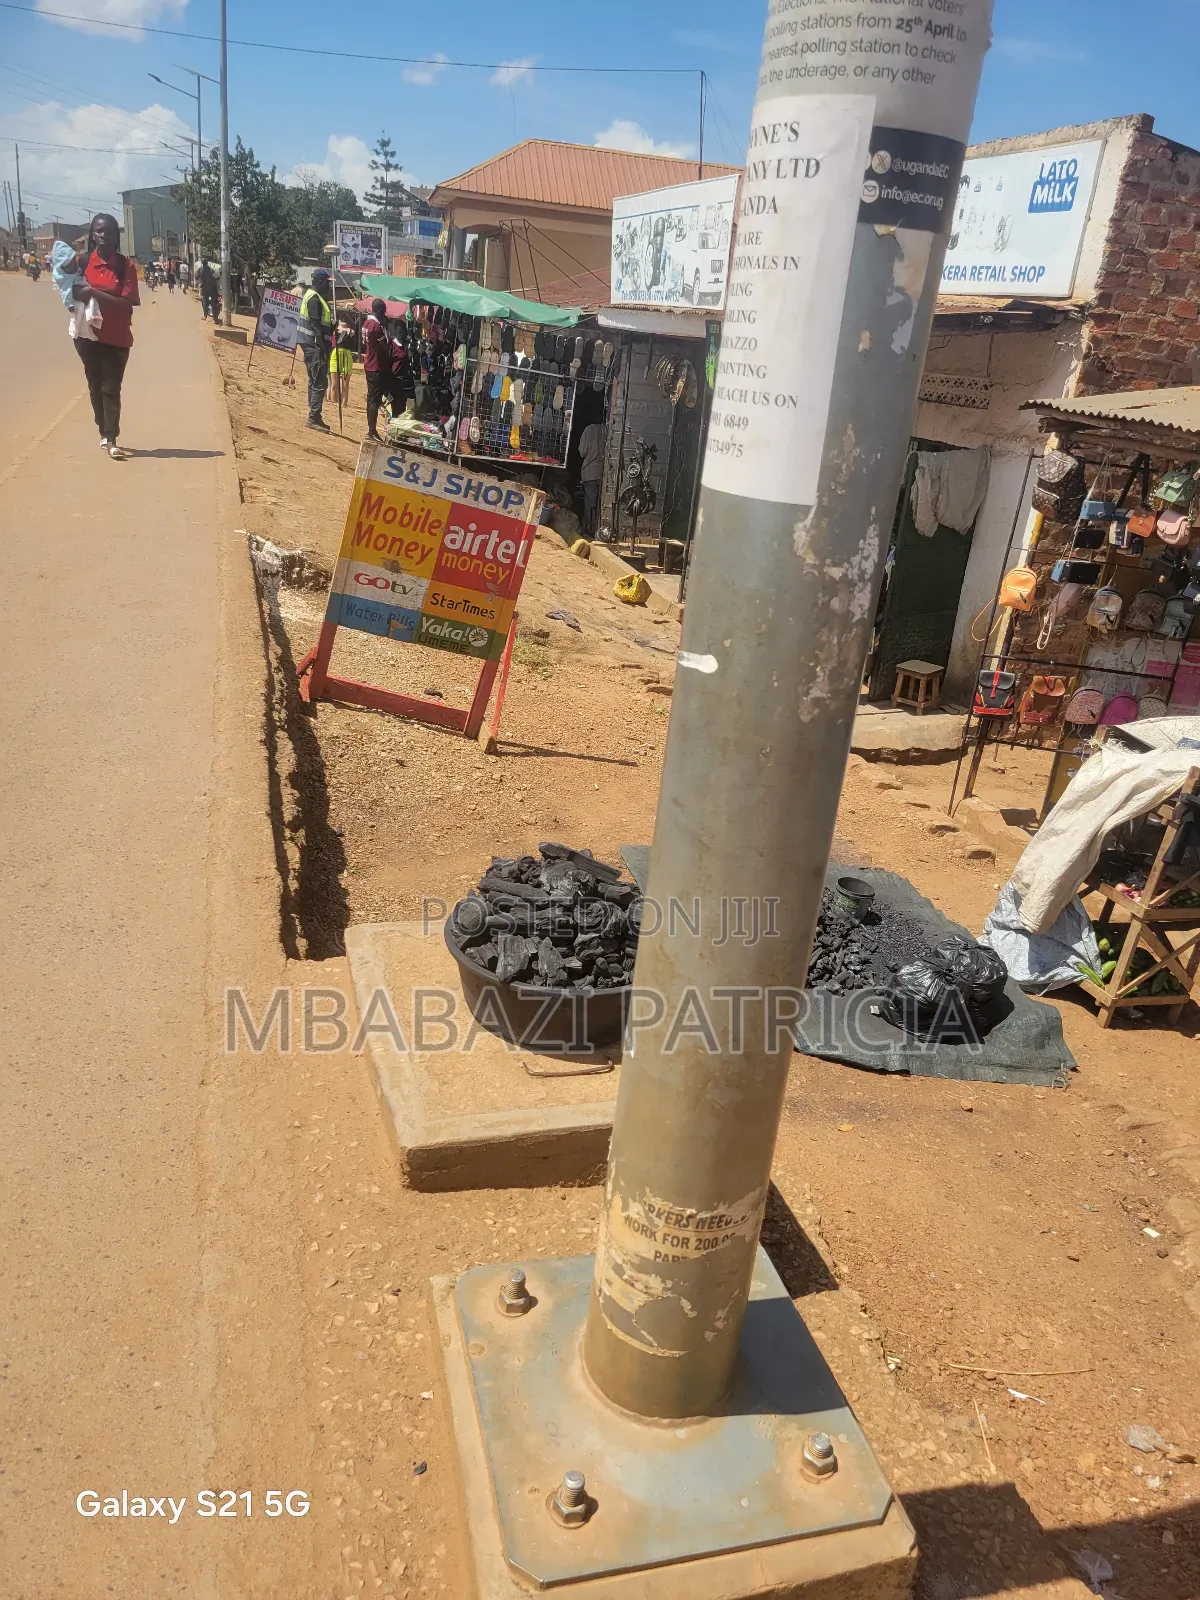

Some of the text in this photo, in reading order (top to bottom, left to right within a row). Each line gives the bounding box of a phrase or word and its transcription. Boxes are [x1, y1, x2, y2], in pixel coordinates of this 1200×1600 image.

[801, 13, 852, 31] stations
[856, 12, 892, 30] from
[895, 16, 923, 33] 25th
[924, 18, 955, 39] April
[801, 37, 847, 59] polling
[850, 37, 900, 55] station
[905, 41, 918, 57] to
[921, 45, 957, 67] check
[769, 68, 784, 83] the
[853, 65, 870, 78] or
[872, 66, 899, 83] any
[902, 67, 936, 84] other
[776, 157, 820, 178] LTD
[892, 158, 949, 178] @ugandaEC
[1038, 158, 1078, 181] LATO
[783, 256, 801, 271] IN
[969, 265, 1007, 282] RETAIL
[1010, 265, 1046, 283] SHOP
[270, 290, 297, 306] JESUS
[285, 305, 301, 314] SALO
[752, 391, 771, 406] US
[775, 393, 799, 408] ON
[724, 414, 748, 430] 6849
[384, 456, 525, 510] S&J SHOP
[360, 492, 443, 537] Mobile
[351, 521, 434, 566] Money
[444, 523, 528, 568] airtel
[441, 551, 510, 585] money
[345, 602, 385, 622] Water
[430, 593, 496, 620] StarTimes
[420, 616, 470, 642] Yaka!
[624, 1214, 657, 1242] WORK
[662, 1232, 690, 1250] FOR
